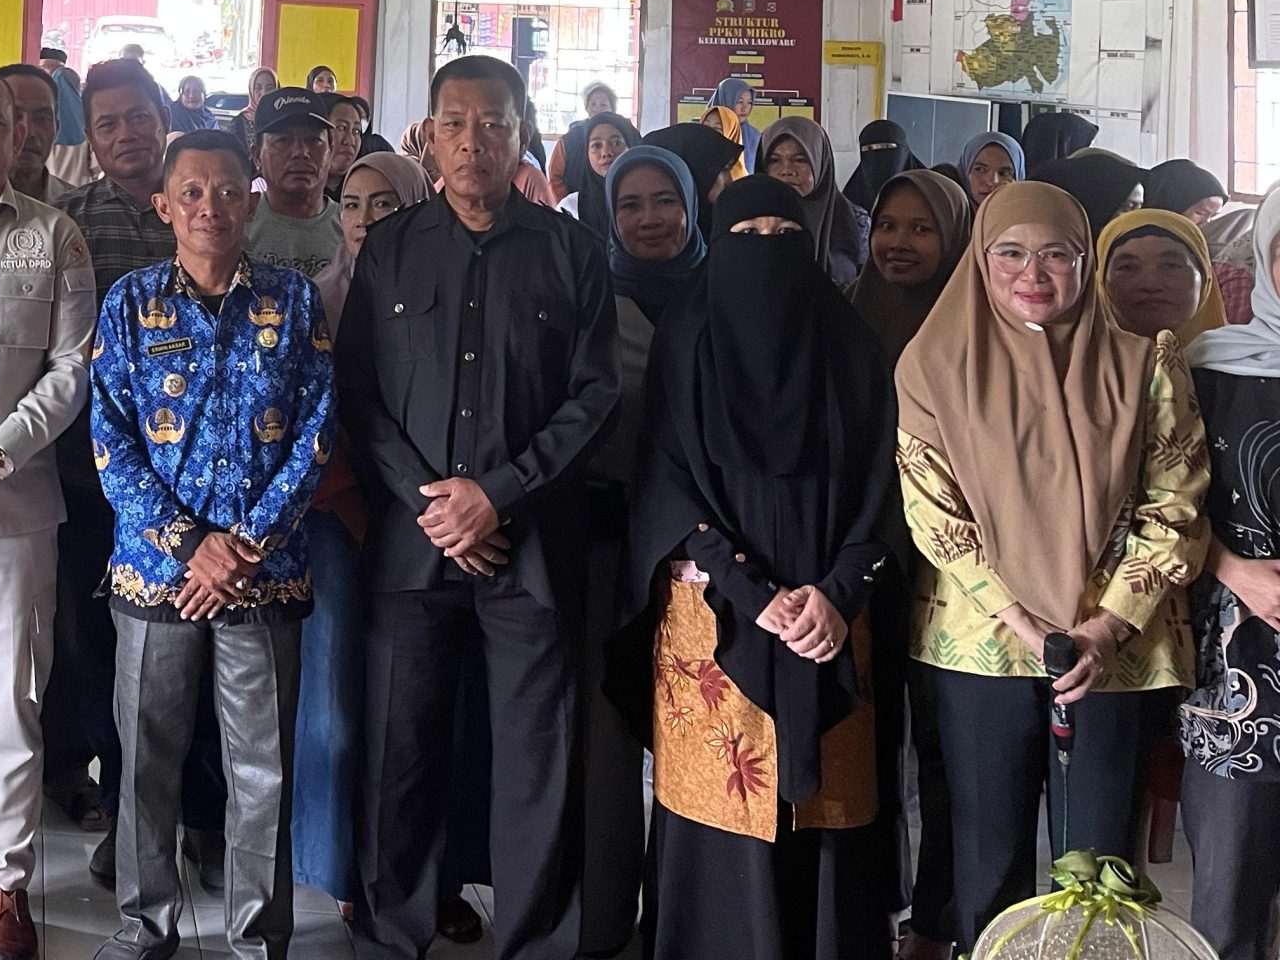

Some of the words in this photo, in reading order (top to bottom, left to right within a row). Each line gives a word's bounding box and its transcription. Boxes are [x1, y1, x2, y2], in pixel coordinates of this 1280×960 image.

[715, 16, 779, 28] STRUKTUR
[709, 27, 742, 37] PPKM
[746, 28, 786, 38] MIKRO
[698, 36, 750, 45] KELURAHAN
[751, 38, 796, 47] LALOWARU
[0, 259, 28, 269] KETUA
[29, 259, 52, 269] DPRD
